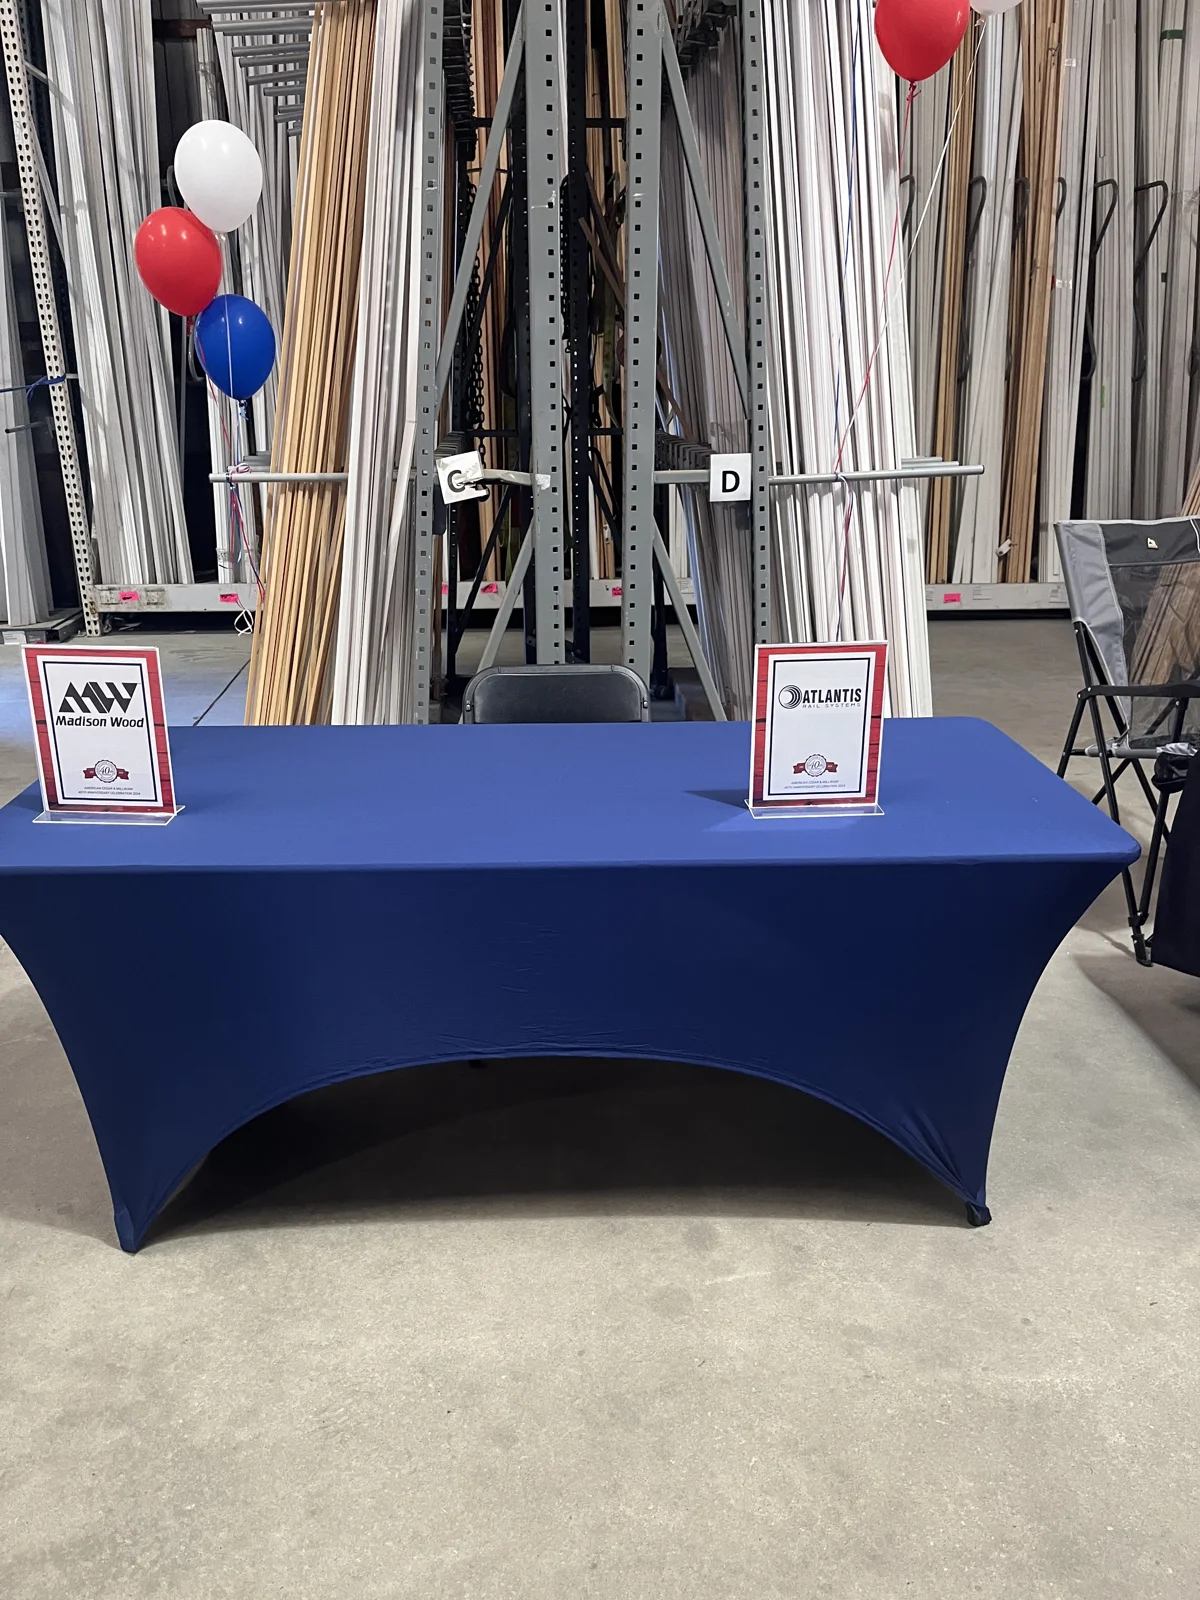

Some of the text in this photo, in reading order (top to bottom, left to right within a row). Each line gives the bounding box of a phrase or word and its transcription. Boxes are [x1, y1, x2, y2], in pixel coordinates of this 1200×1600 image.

[447, 469, 466, 493] C
[721, 470, 740, 493] D
[802, 688, 862, 703] ATLANTIS
[55, 715, 144, 728] Madison Wood
